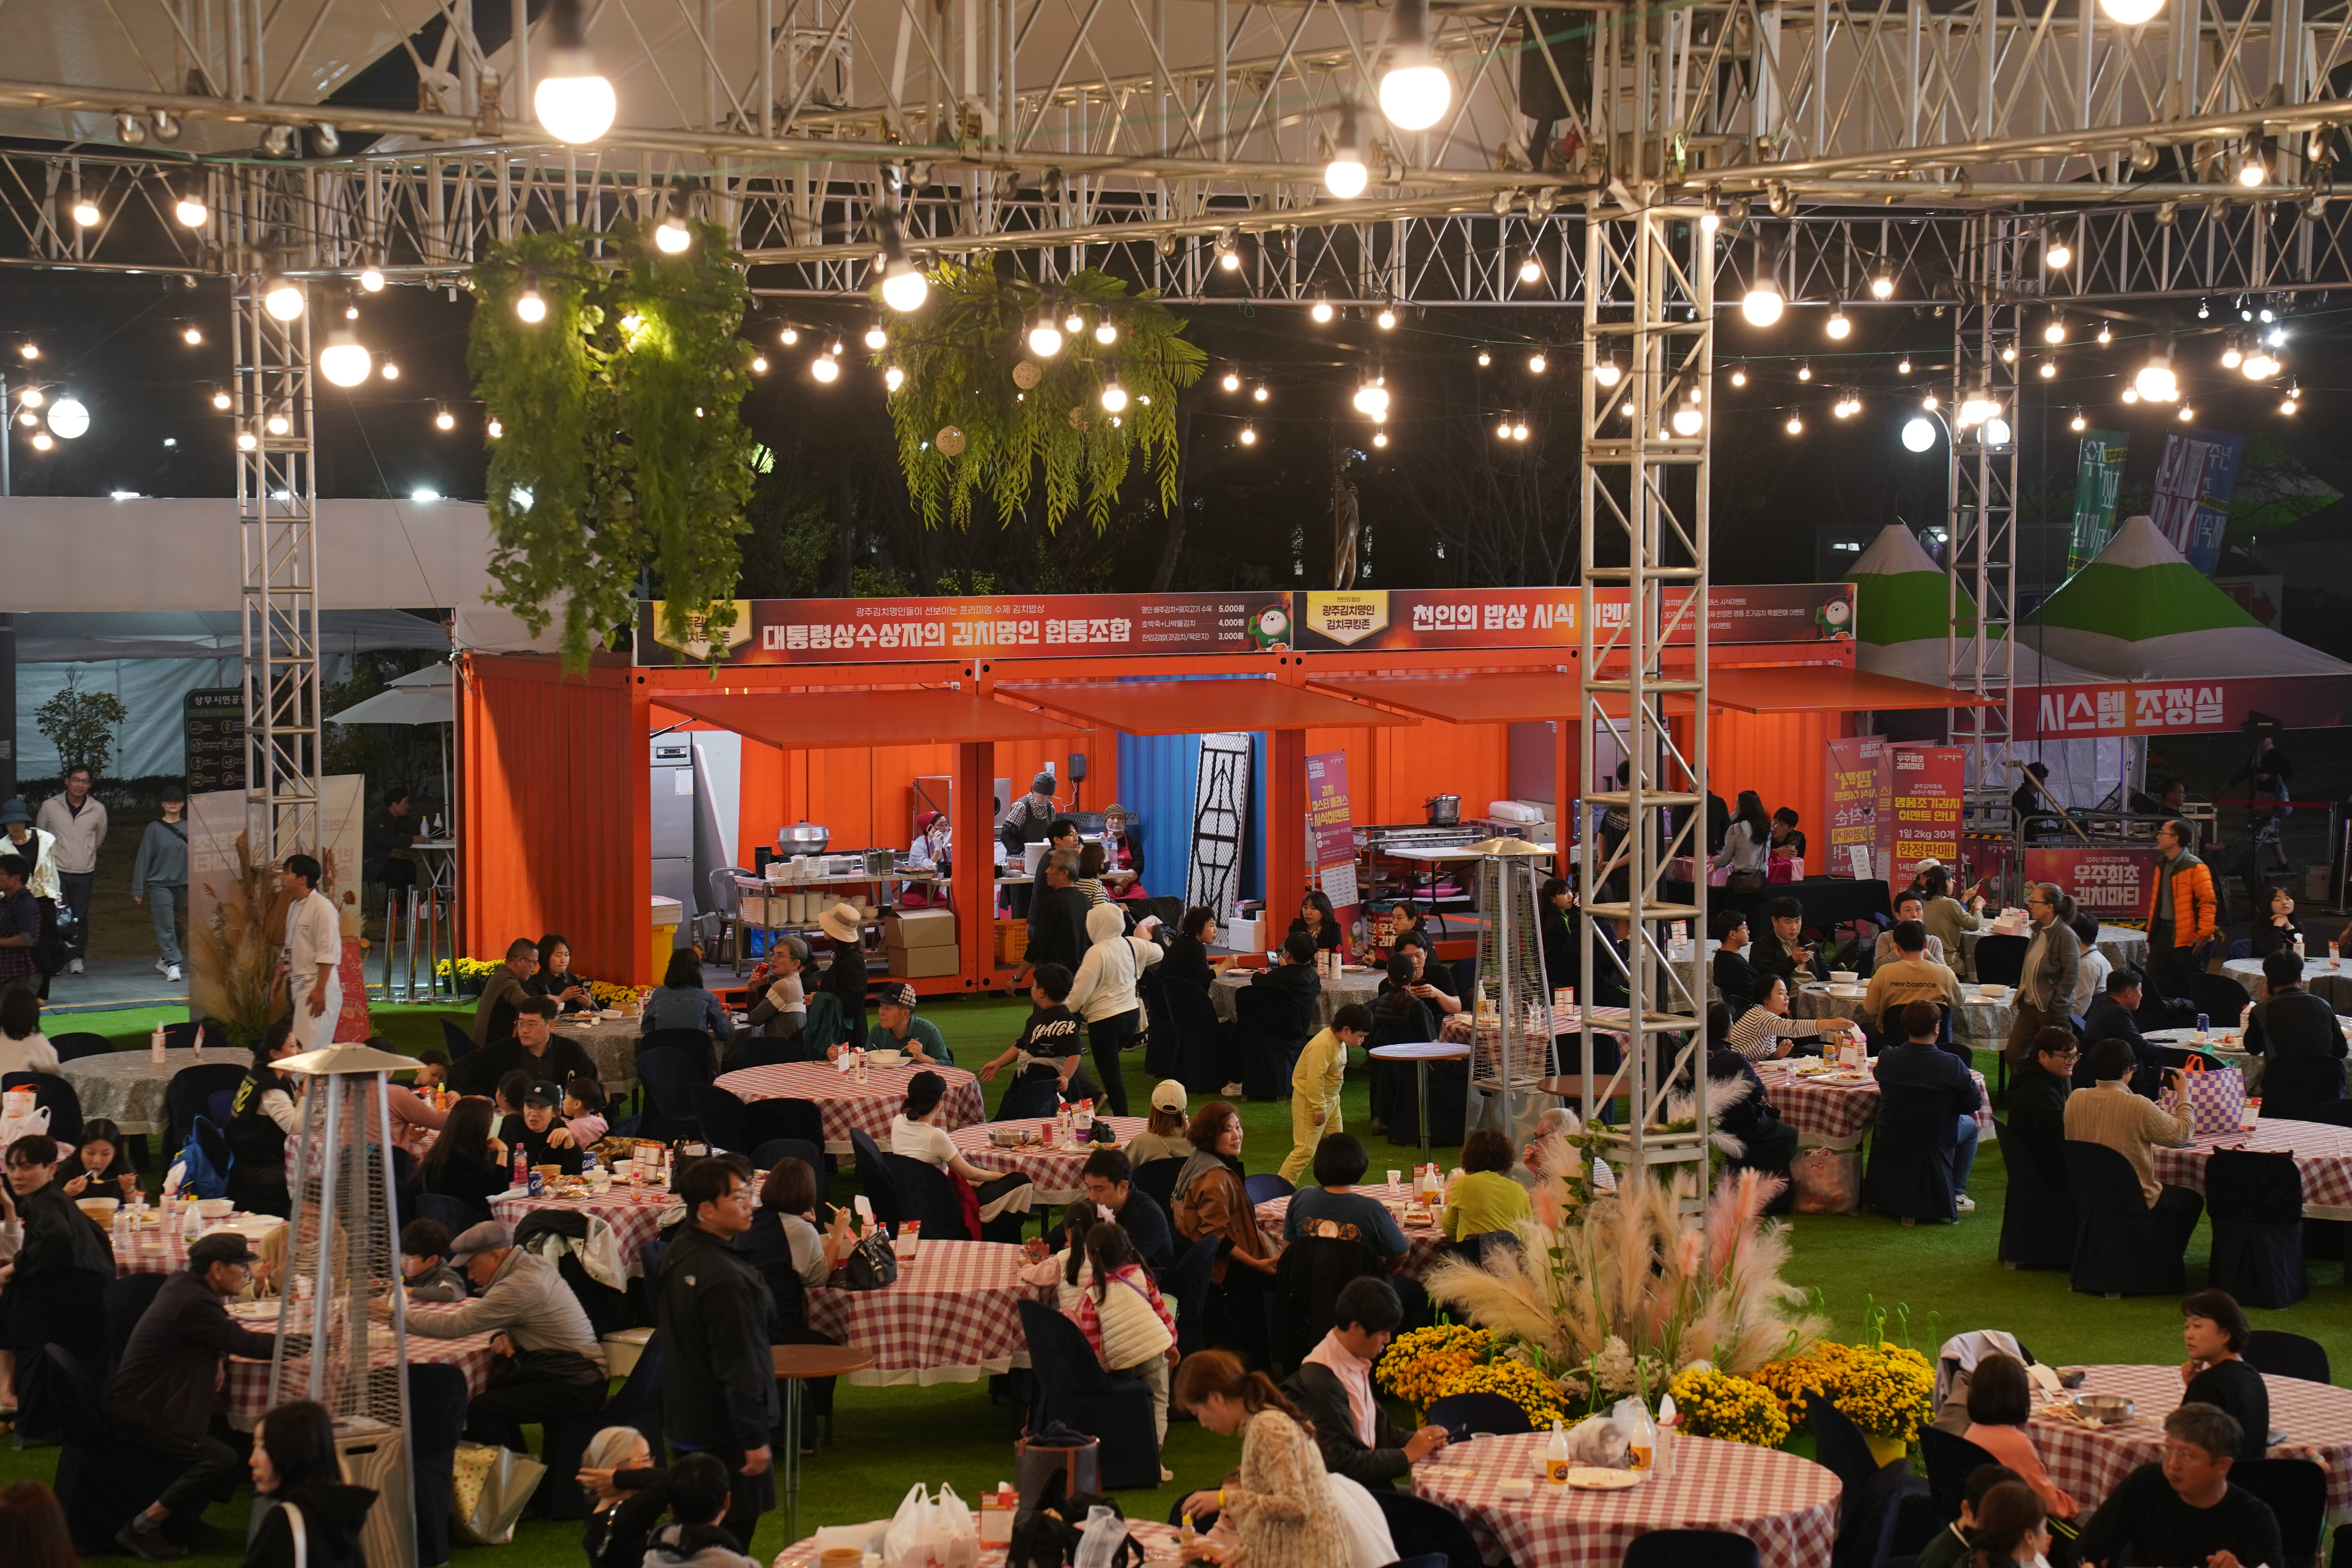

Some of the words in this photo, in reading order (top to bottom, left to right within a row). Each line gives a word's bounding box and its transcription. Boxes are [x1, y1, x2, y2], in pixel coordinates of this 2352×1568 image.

[856, 607, 922, 617] 광주김치명인들이
[925, 606, 957, 615] 선보이는
[960, 605, 992, 615] 프리미엄
[994, 604, 1011, 614] 수제
[1013, 604, 1045, 614] 김치밥상
[1322, 605, 1374, 616] 광주김치명인
[1413, 604, 1477, 630] 천인의
[1485, 604, 1527, 629] 밥상
[1533, 604, 1575, 628] 시식
[1142, 619, 1196, 628] 호박죽+나박물김치
[1218, 619, 1244, 627] 4,000원
[1327, 619, 1370, 630] 김치쿠킹존
[763, 622, 945, 650] 대통령상수상자의
[952, 620, 1039, 646] 김치명인
[1045, 617, 1132, 644] 협동조합
[2037, 691, 2125, 732] 시스템
[2135, 687, 2223, 727] 조정실
[1321, 784, 1334, 797] 김치
[1312, 798, 1330, 812] 마스터
[1330, 795, 1348, 808] 클래스
[1895, 797, 1960, 809] 명품조기김치
[1314, 807, 1350, 827] 시식이벤트
[1899, 810, 1931, 821] 이벤트
[1934, 811, 1956, 822] 안내
[1898, 829, 1912, 838] 1일
[1914, 830, 1931, 840] 2kg
[1933, 830, 1955, 839] 30개
[1898, 843, 1954, 858] 한정판매!
[2074, 865, 2140, 884] 우주최초
[2074, 887, 2140, 906] 김치파티
[1030, 1020, 1076, 1044] SKATER
